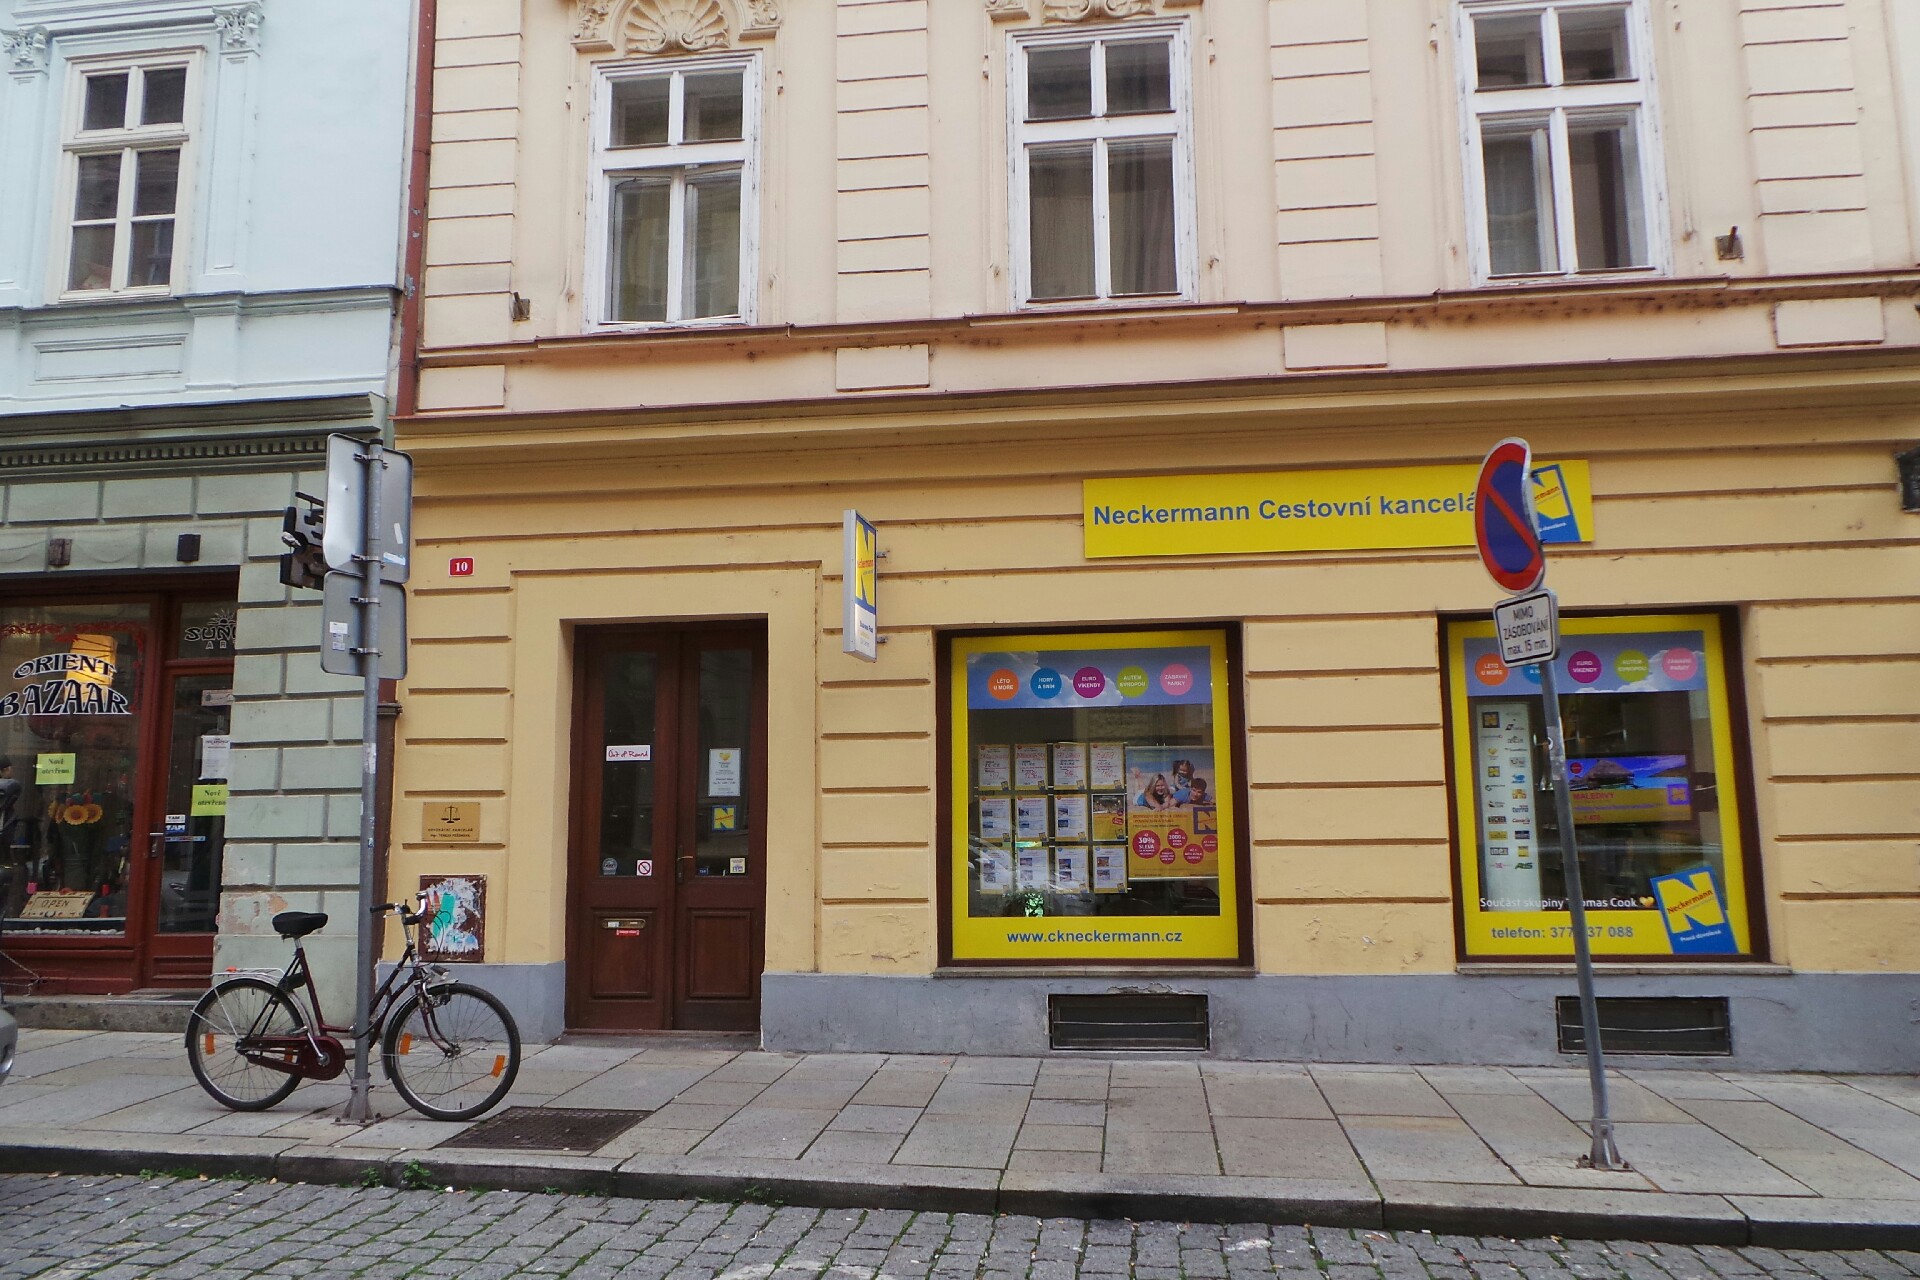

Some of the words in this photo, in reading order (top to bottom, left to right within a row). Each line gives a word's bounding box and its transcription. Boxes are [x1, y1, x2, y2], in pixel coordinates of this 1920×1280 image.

[1093, 504, 1250, 525] Neckermann
[1259, 496, 1371, 519] Cestovní
[1379, 491, 1476, 515] kancelá
[455, 561, 468, 572] 10
[1512, 605, 1534, 621] MIMO
[1503, 616, 1549, 640] ZÁSOBOVÁNÍ
[1525, 639, 1532, 651] 15
[12, 652, 118, 680] ORIENT
[0, 679, 132, 718] BAZAAR
[41, 899, 69, 908] OPEN
[1609, 897, 1638, 908] Cook
[1666, 889, 1714, 915] Neckermann
[1007, 930, 1183, 943] www.ckneckermann.cz
[1491, 926, 1546, 939] telefon:
[1550, 926, 1573, 938] 377
[1608, 926, 1634, 938] 088
